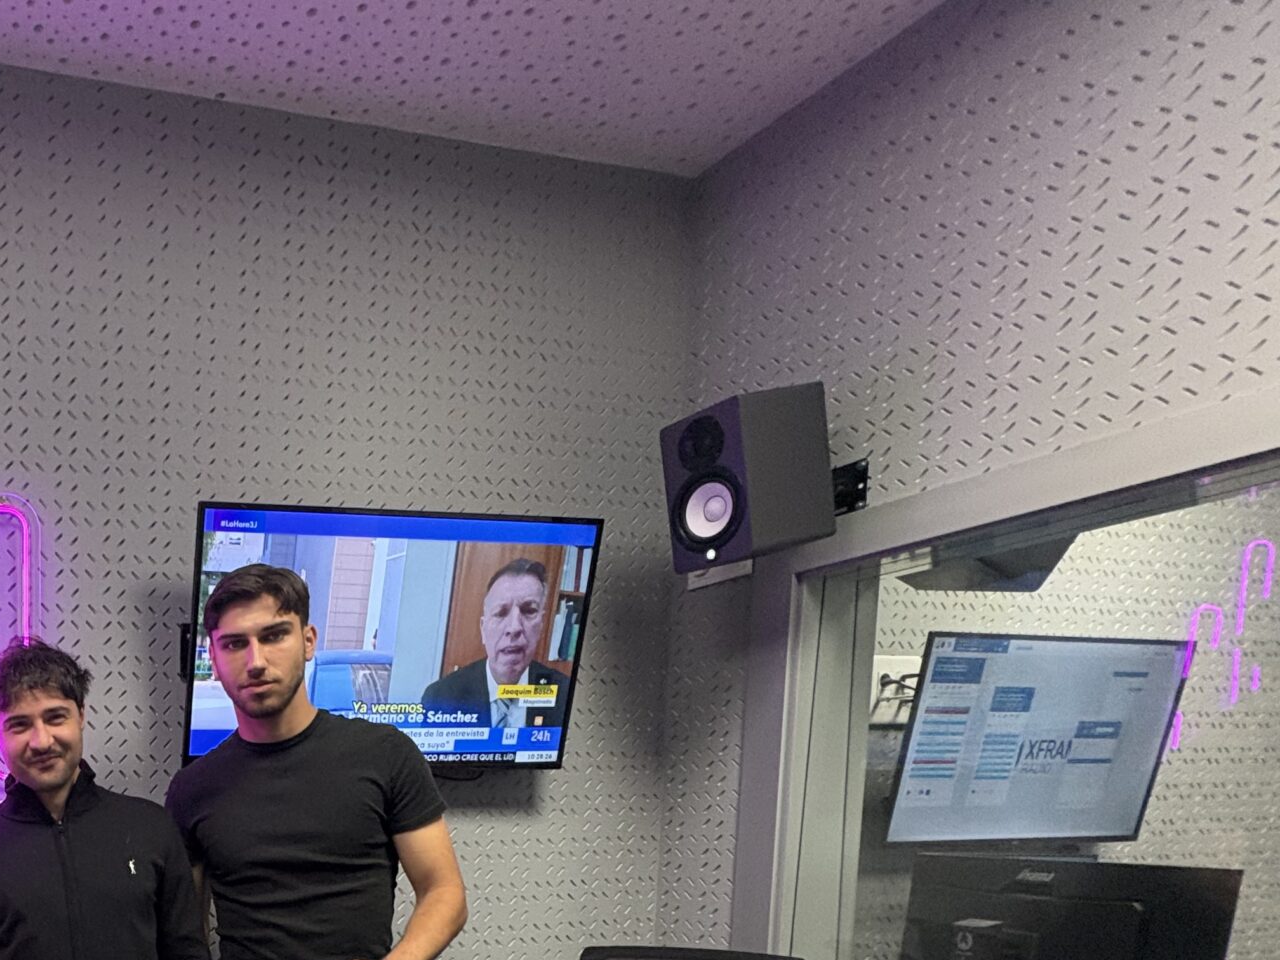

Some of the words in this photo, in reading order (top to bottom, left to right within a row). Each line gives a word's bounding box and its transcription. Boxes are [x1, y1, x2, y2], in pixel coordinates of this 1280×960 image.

[352, 700, 368, 714] Ya
[371, 703, 427, 714] veremos.
[407, 711, 424, 724] de
[426, 710, 479, 724] Sánchez
[445, 729, 486, 738] entrevista
[530, 729, 551, 742] 24h
[479, 753, 494, 761] QUE
